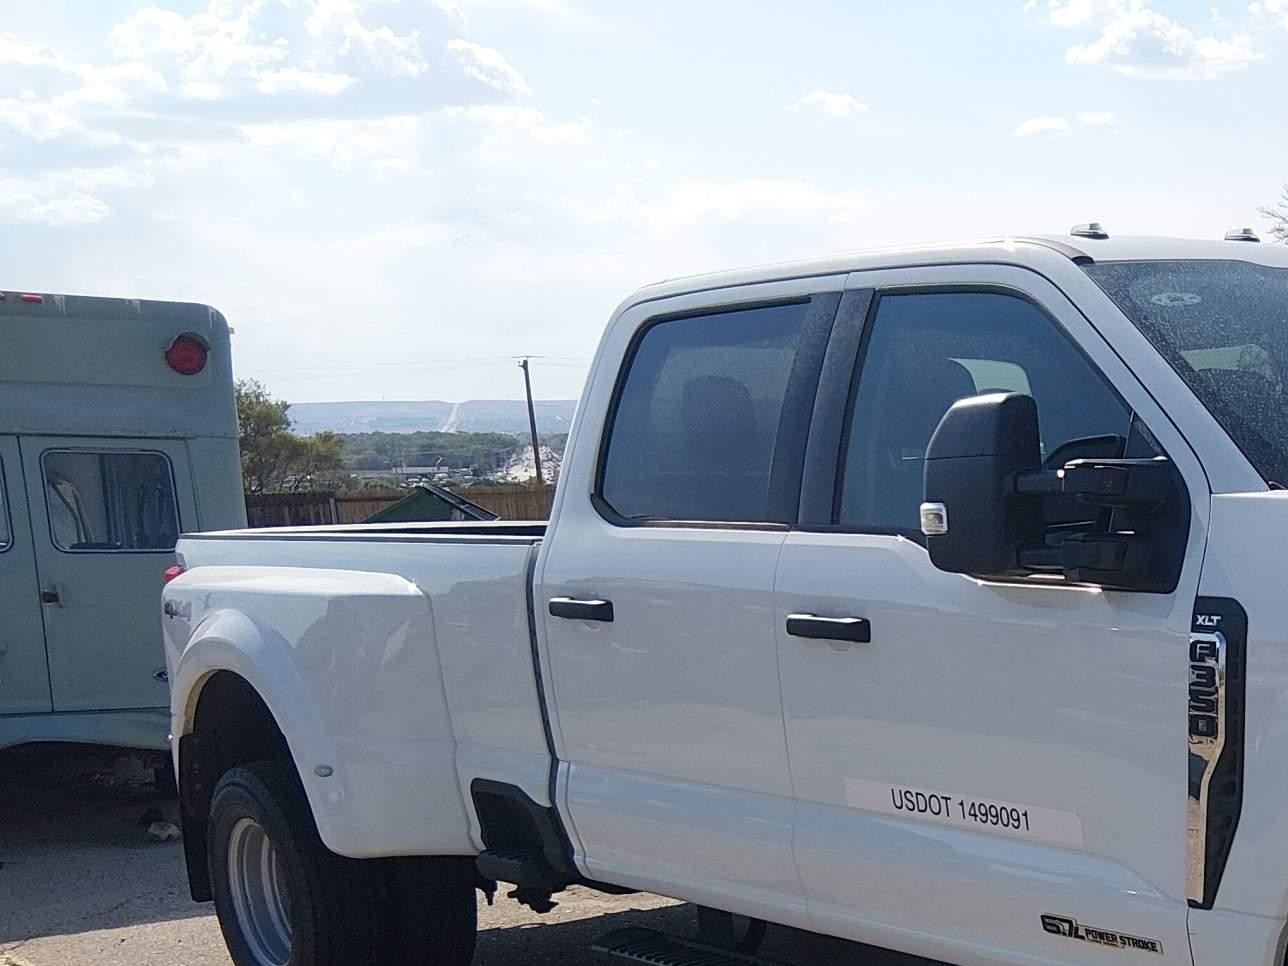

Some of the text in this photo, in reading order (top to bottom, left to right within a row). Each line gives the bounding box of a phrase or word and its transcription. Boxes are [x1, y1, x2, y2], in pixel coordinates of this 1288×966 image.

[1196, 614, 1222, 626] XLT
[891, 788, 1030, 831] USDOT 1499091
[1084, 927, 1119, 943] POWER
[1118, 935, 1159, 952] STROKE
